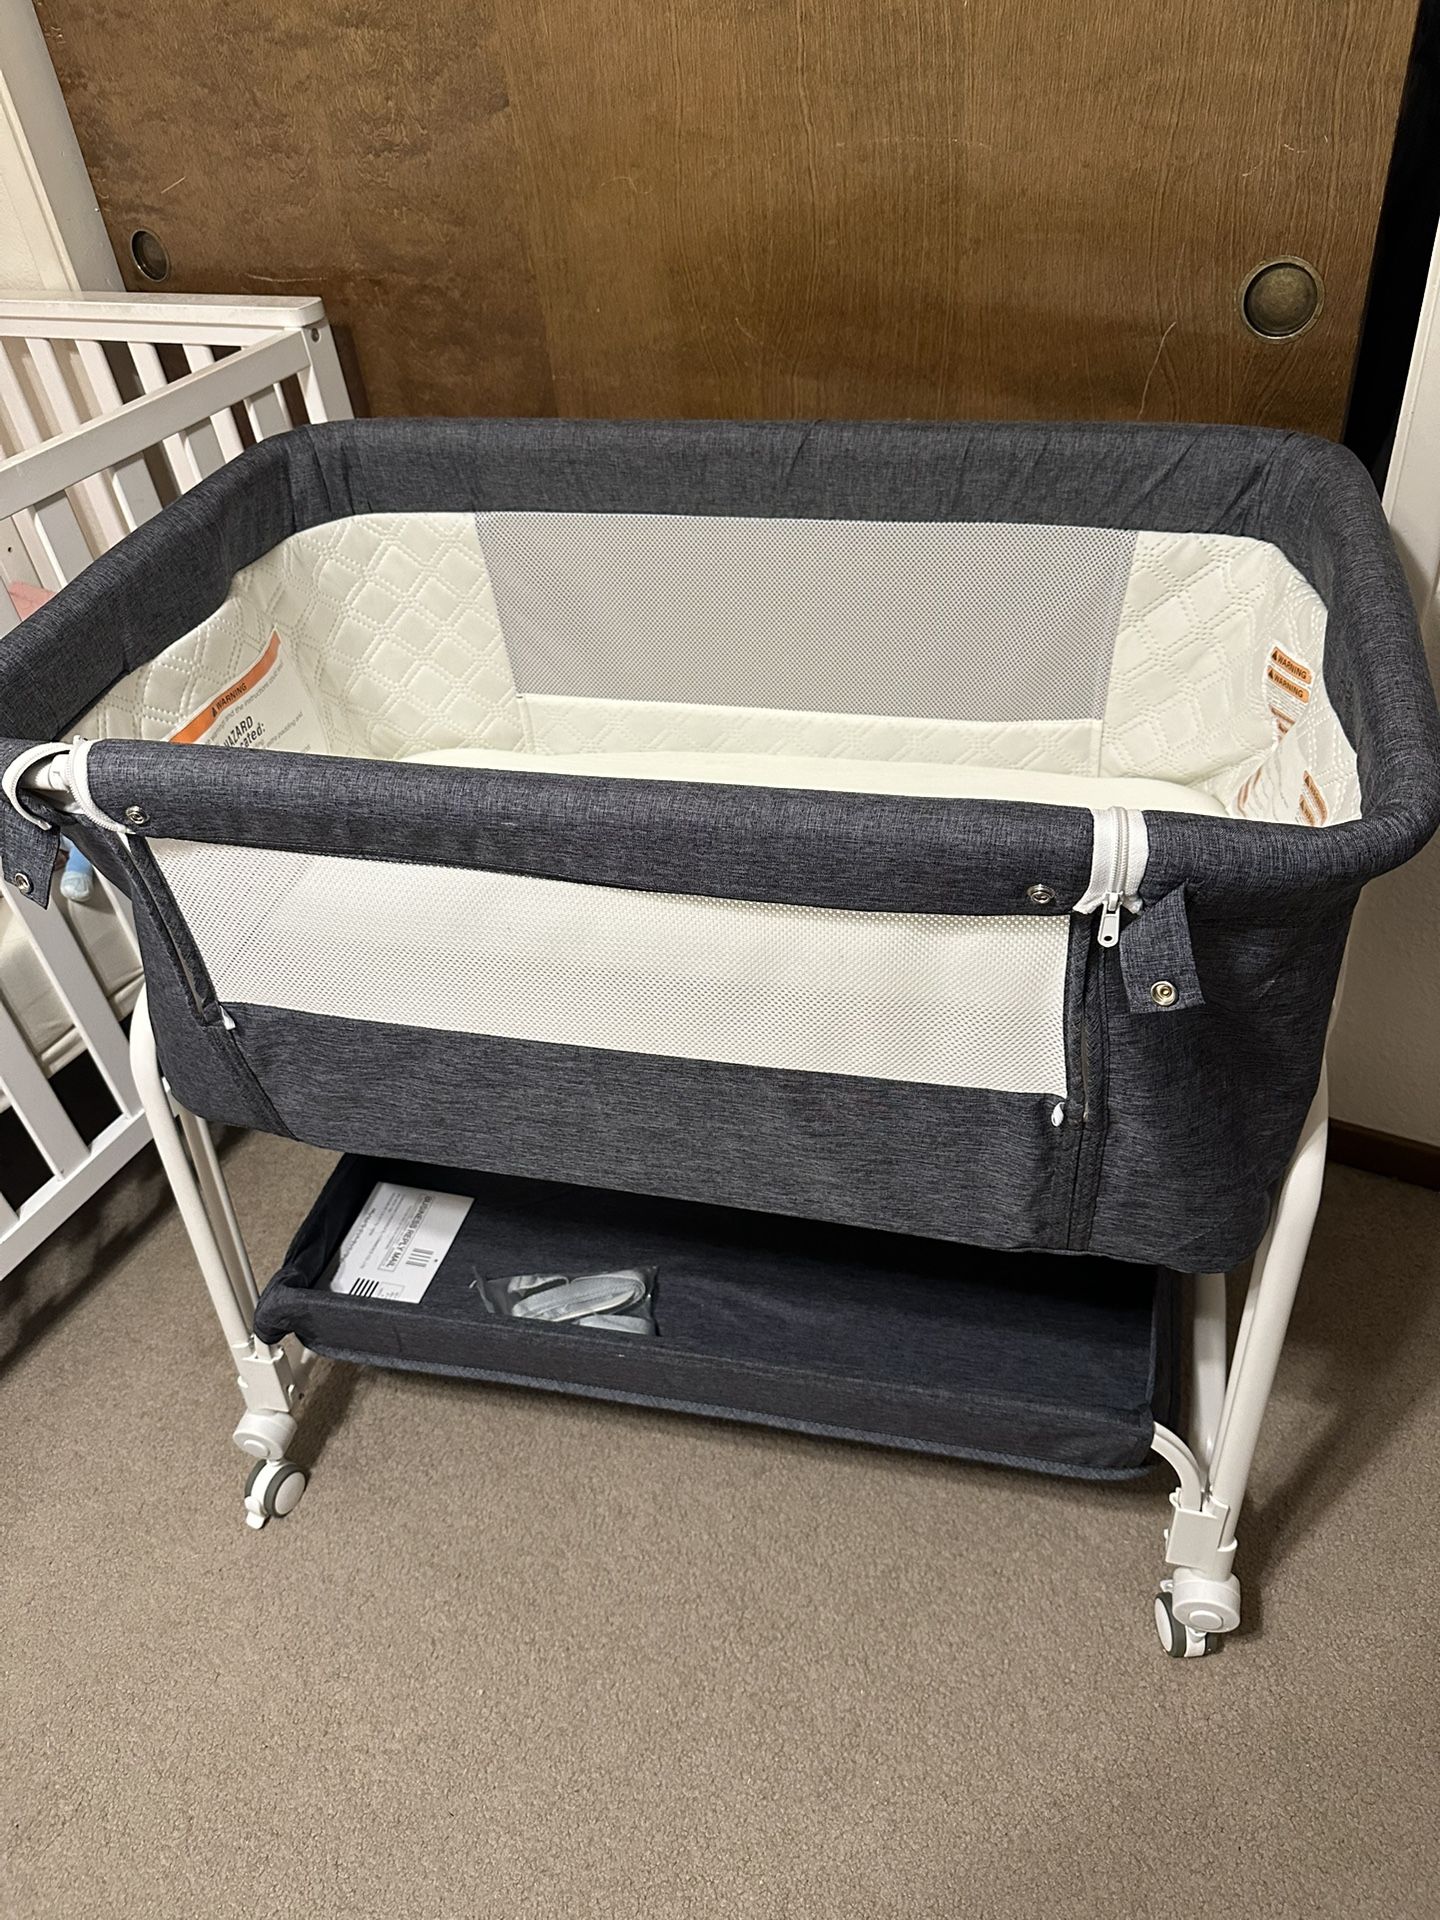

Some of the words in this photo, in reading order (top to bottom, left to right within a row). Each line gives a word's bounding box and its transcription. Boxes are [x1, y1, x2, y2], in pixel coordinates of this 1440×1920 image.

[1278, 654, 1307, 680] WARNING
[216, 682, 248, 710] WARNING
[1274, 673, 1303, 698] WARNING
[240, 722, 266, 748] ated:
[409, 1195, 433, 1229] BUSINESS
[398, 1229, 415, 1252] REPLY
[385, 1251, 401, 1268] MAIL
